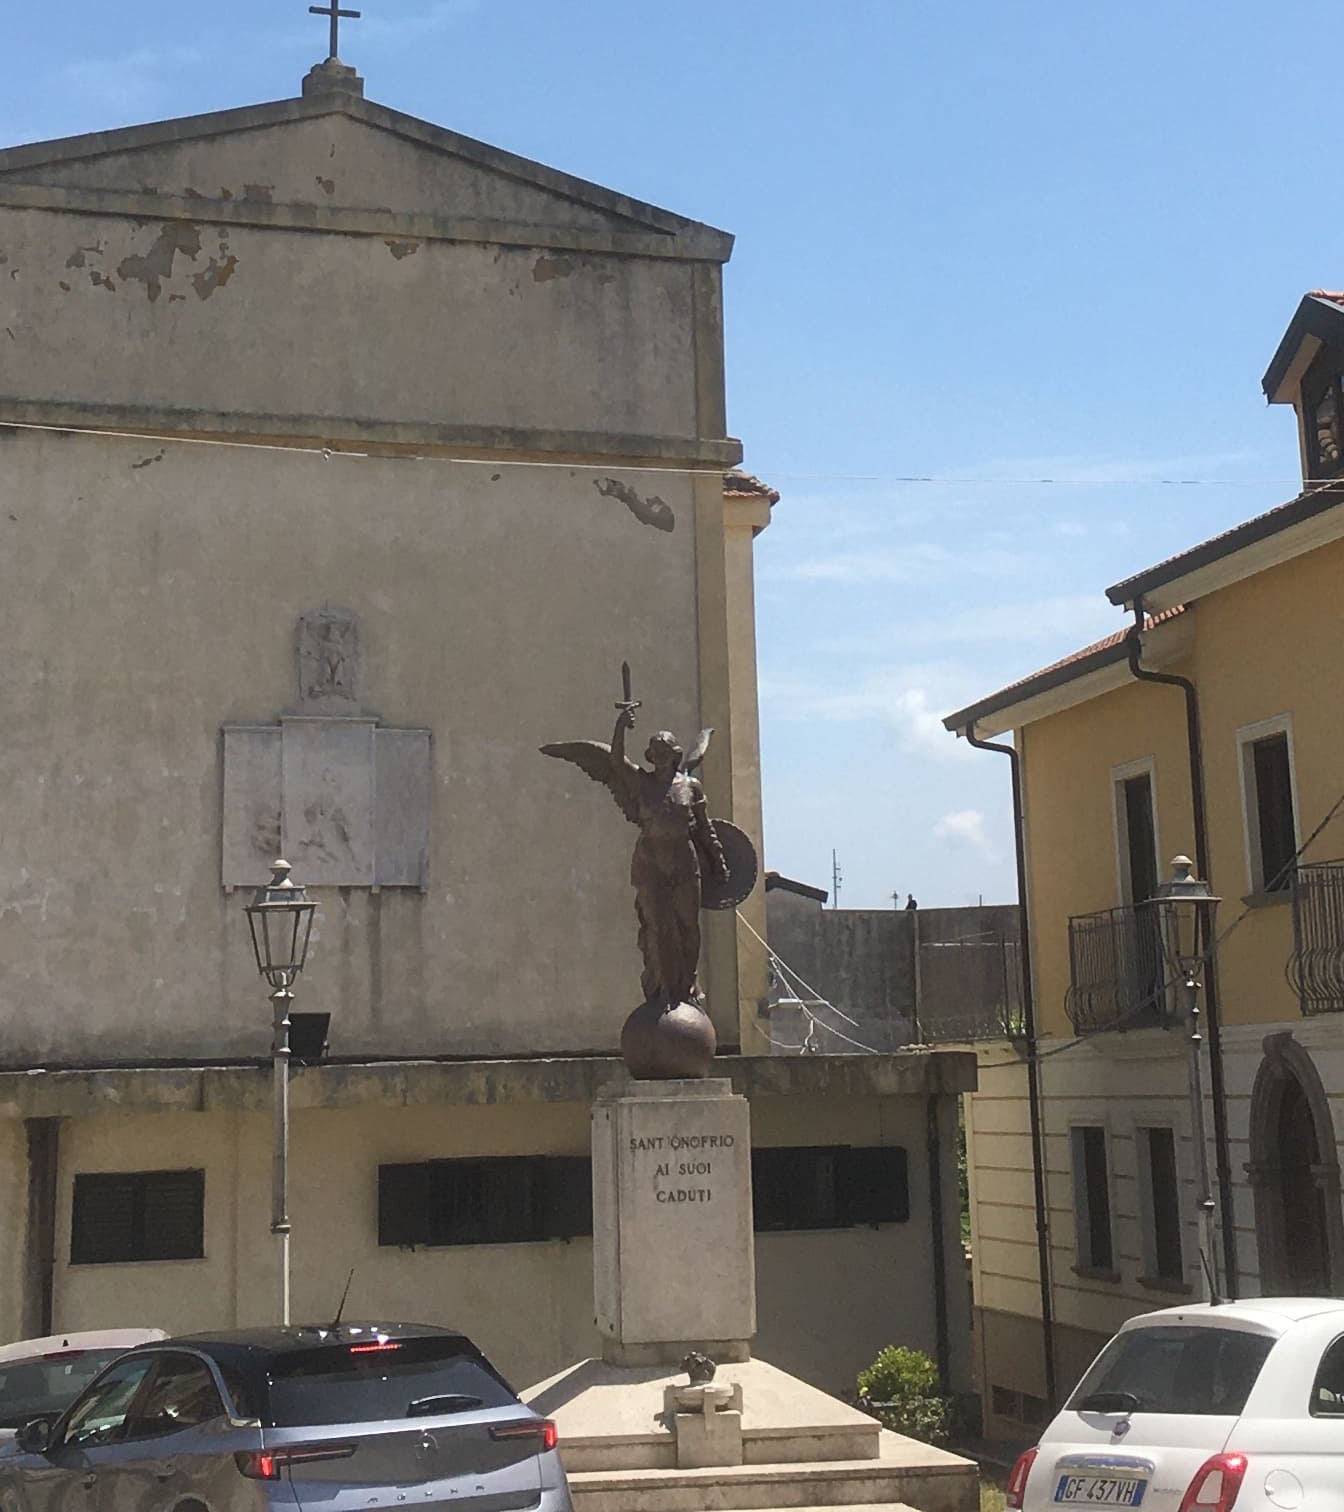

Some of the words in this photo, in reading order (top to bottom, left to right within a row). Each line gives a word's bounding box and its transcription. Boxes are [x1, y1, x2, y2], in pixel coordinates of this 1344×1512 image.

[656, 1163, 670, 1176] AI
[678, 1162, 711, 1175] SUOI
[656, 1189, 711, 1203] CADUTI
